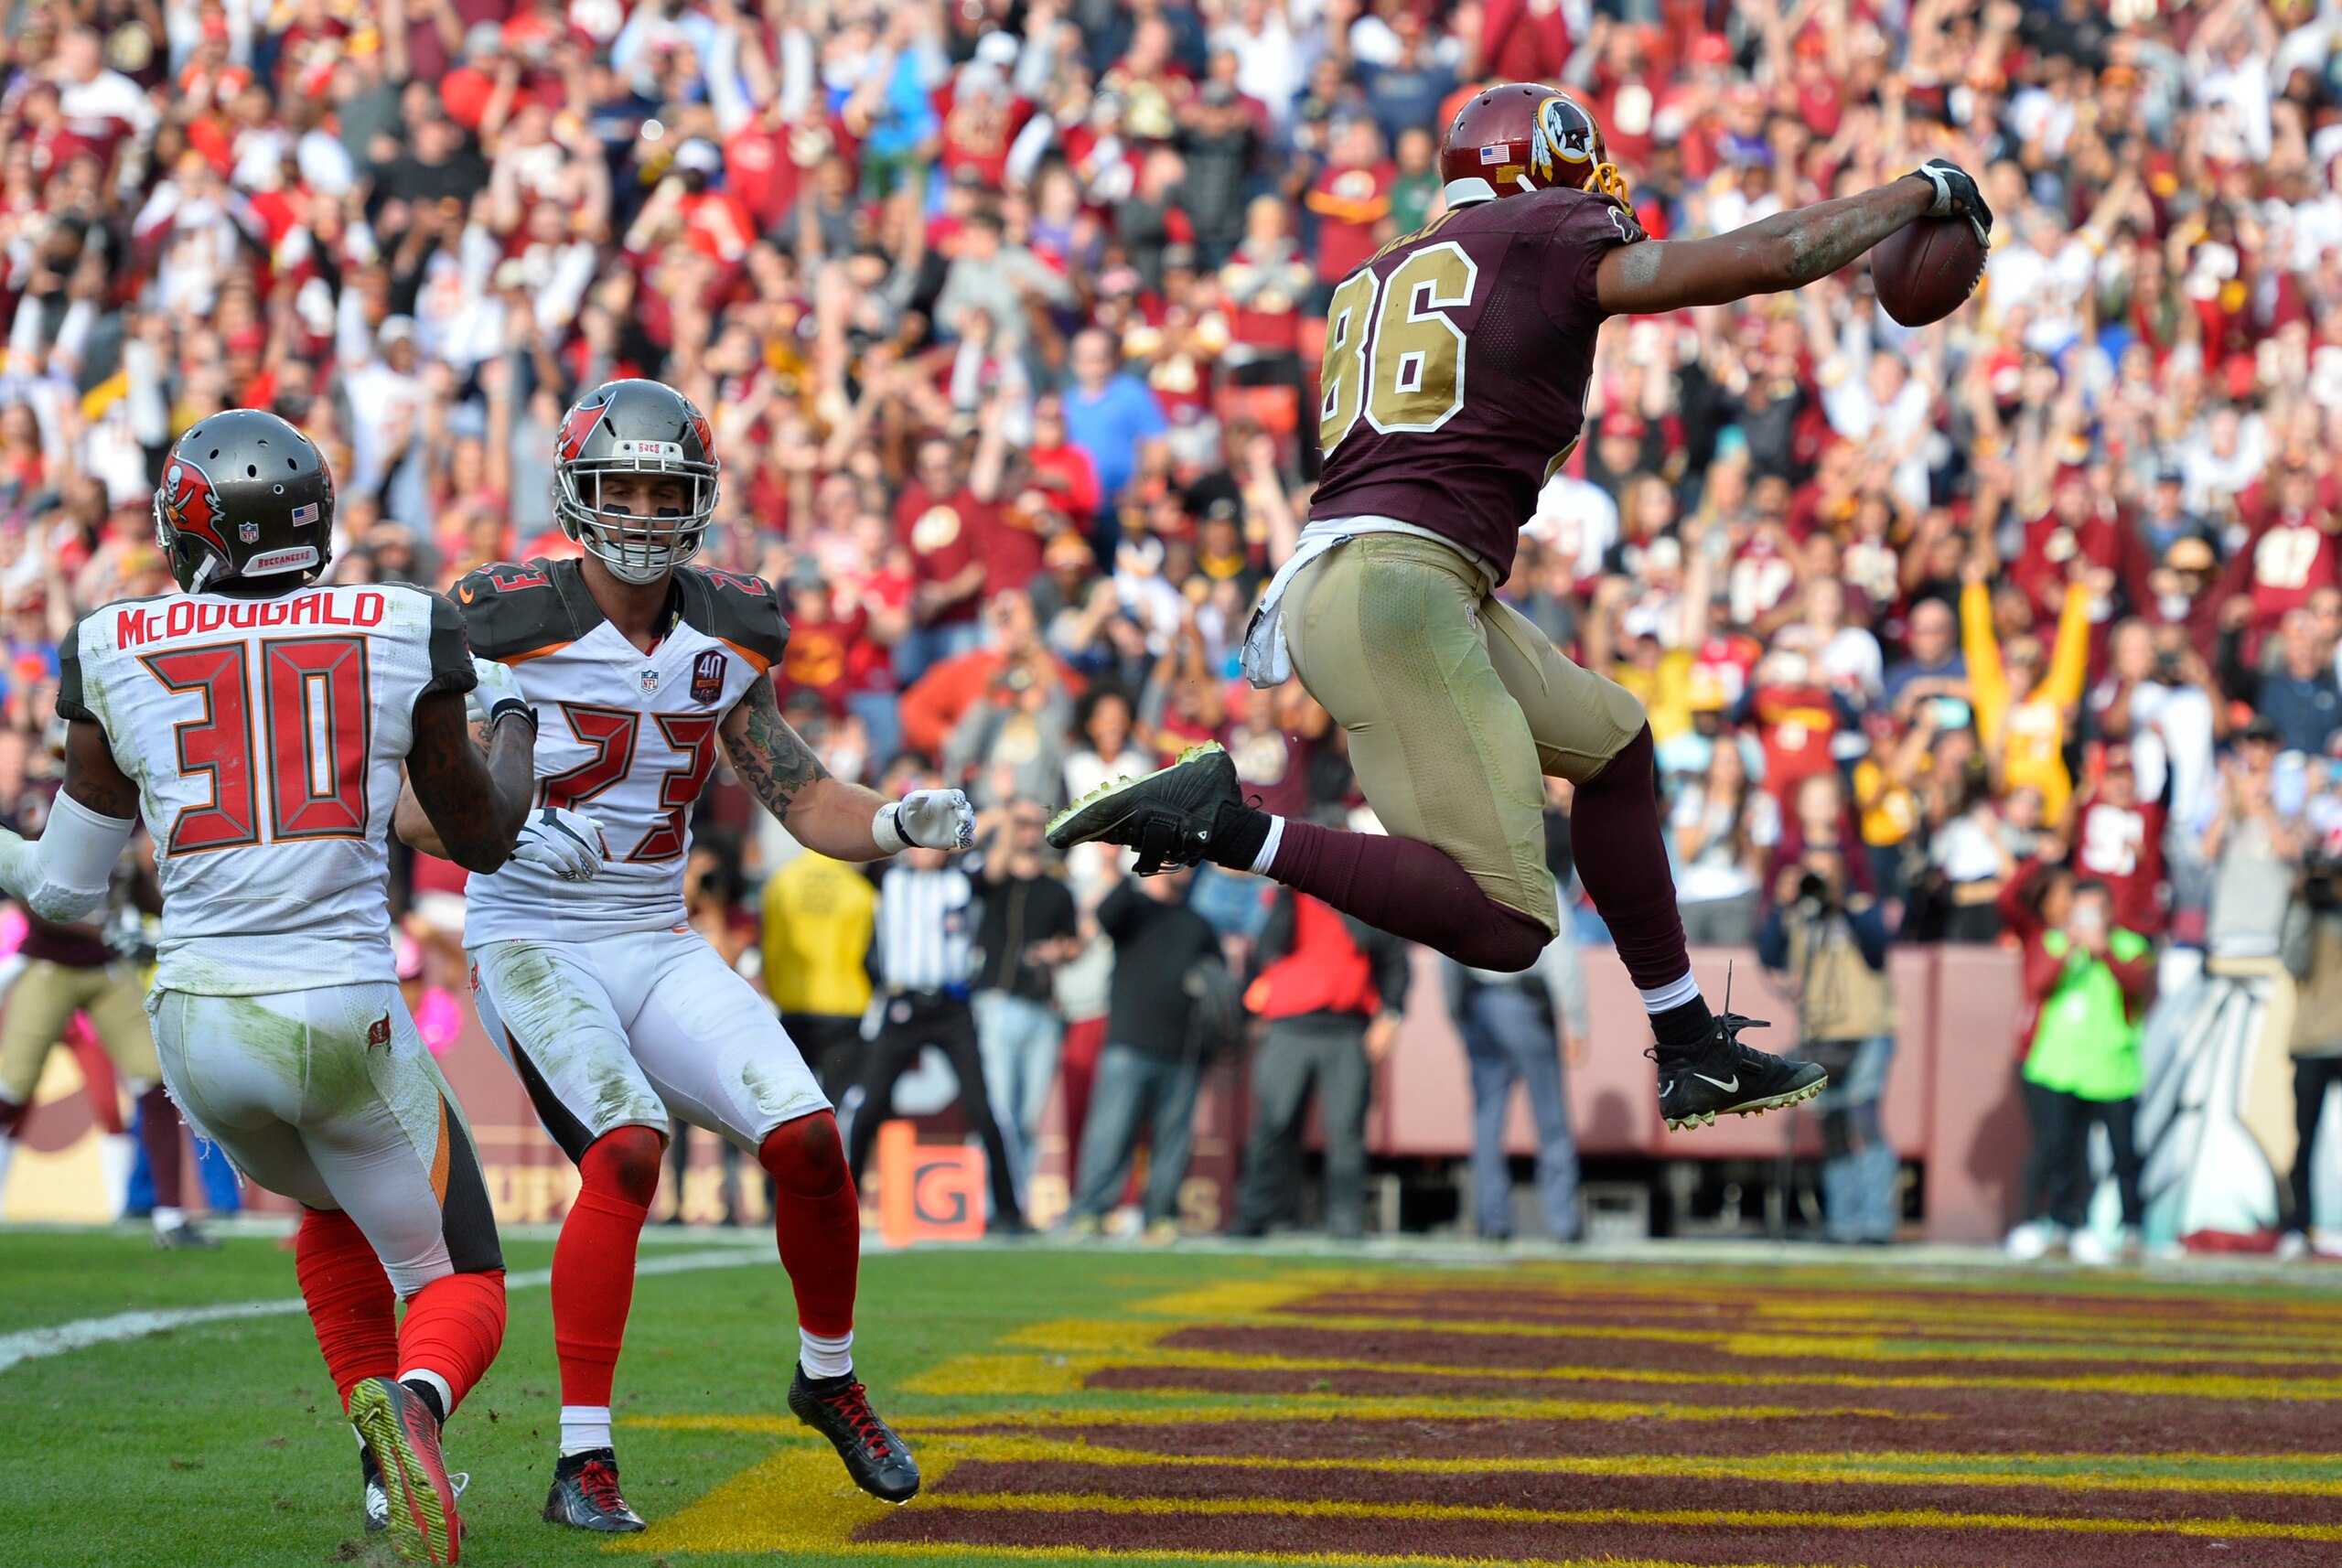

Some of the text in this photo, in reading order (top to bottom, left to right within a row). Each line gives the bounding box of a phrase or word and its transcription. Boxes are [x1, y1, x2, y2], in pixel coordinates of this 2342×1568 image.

[1319, 241, 1479, 460] 86
[258, 551, 310, 568] BUCCANEERS
[116, 592, 385, 650] McDOUGALD
[643, 678, 657, 690] NFL
[698, 654, 723, 678] 40
[134, 632, 372, 858] 30
[536, 701, 719, 864] 23
[915, 1162, 967, 1225] G
